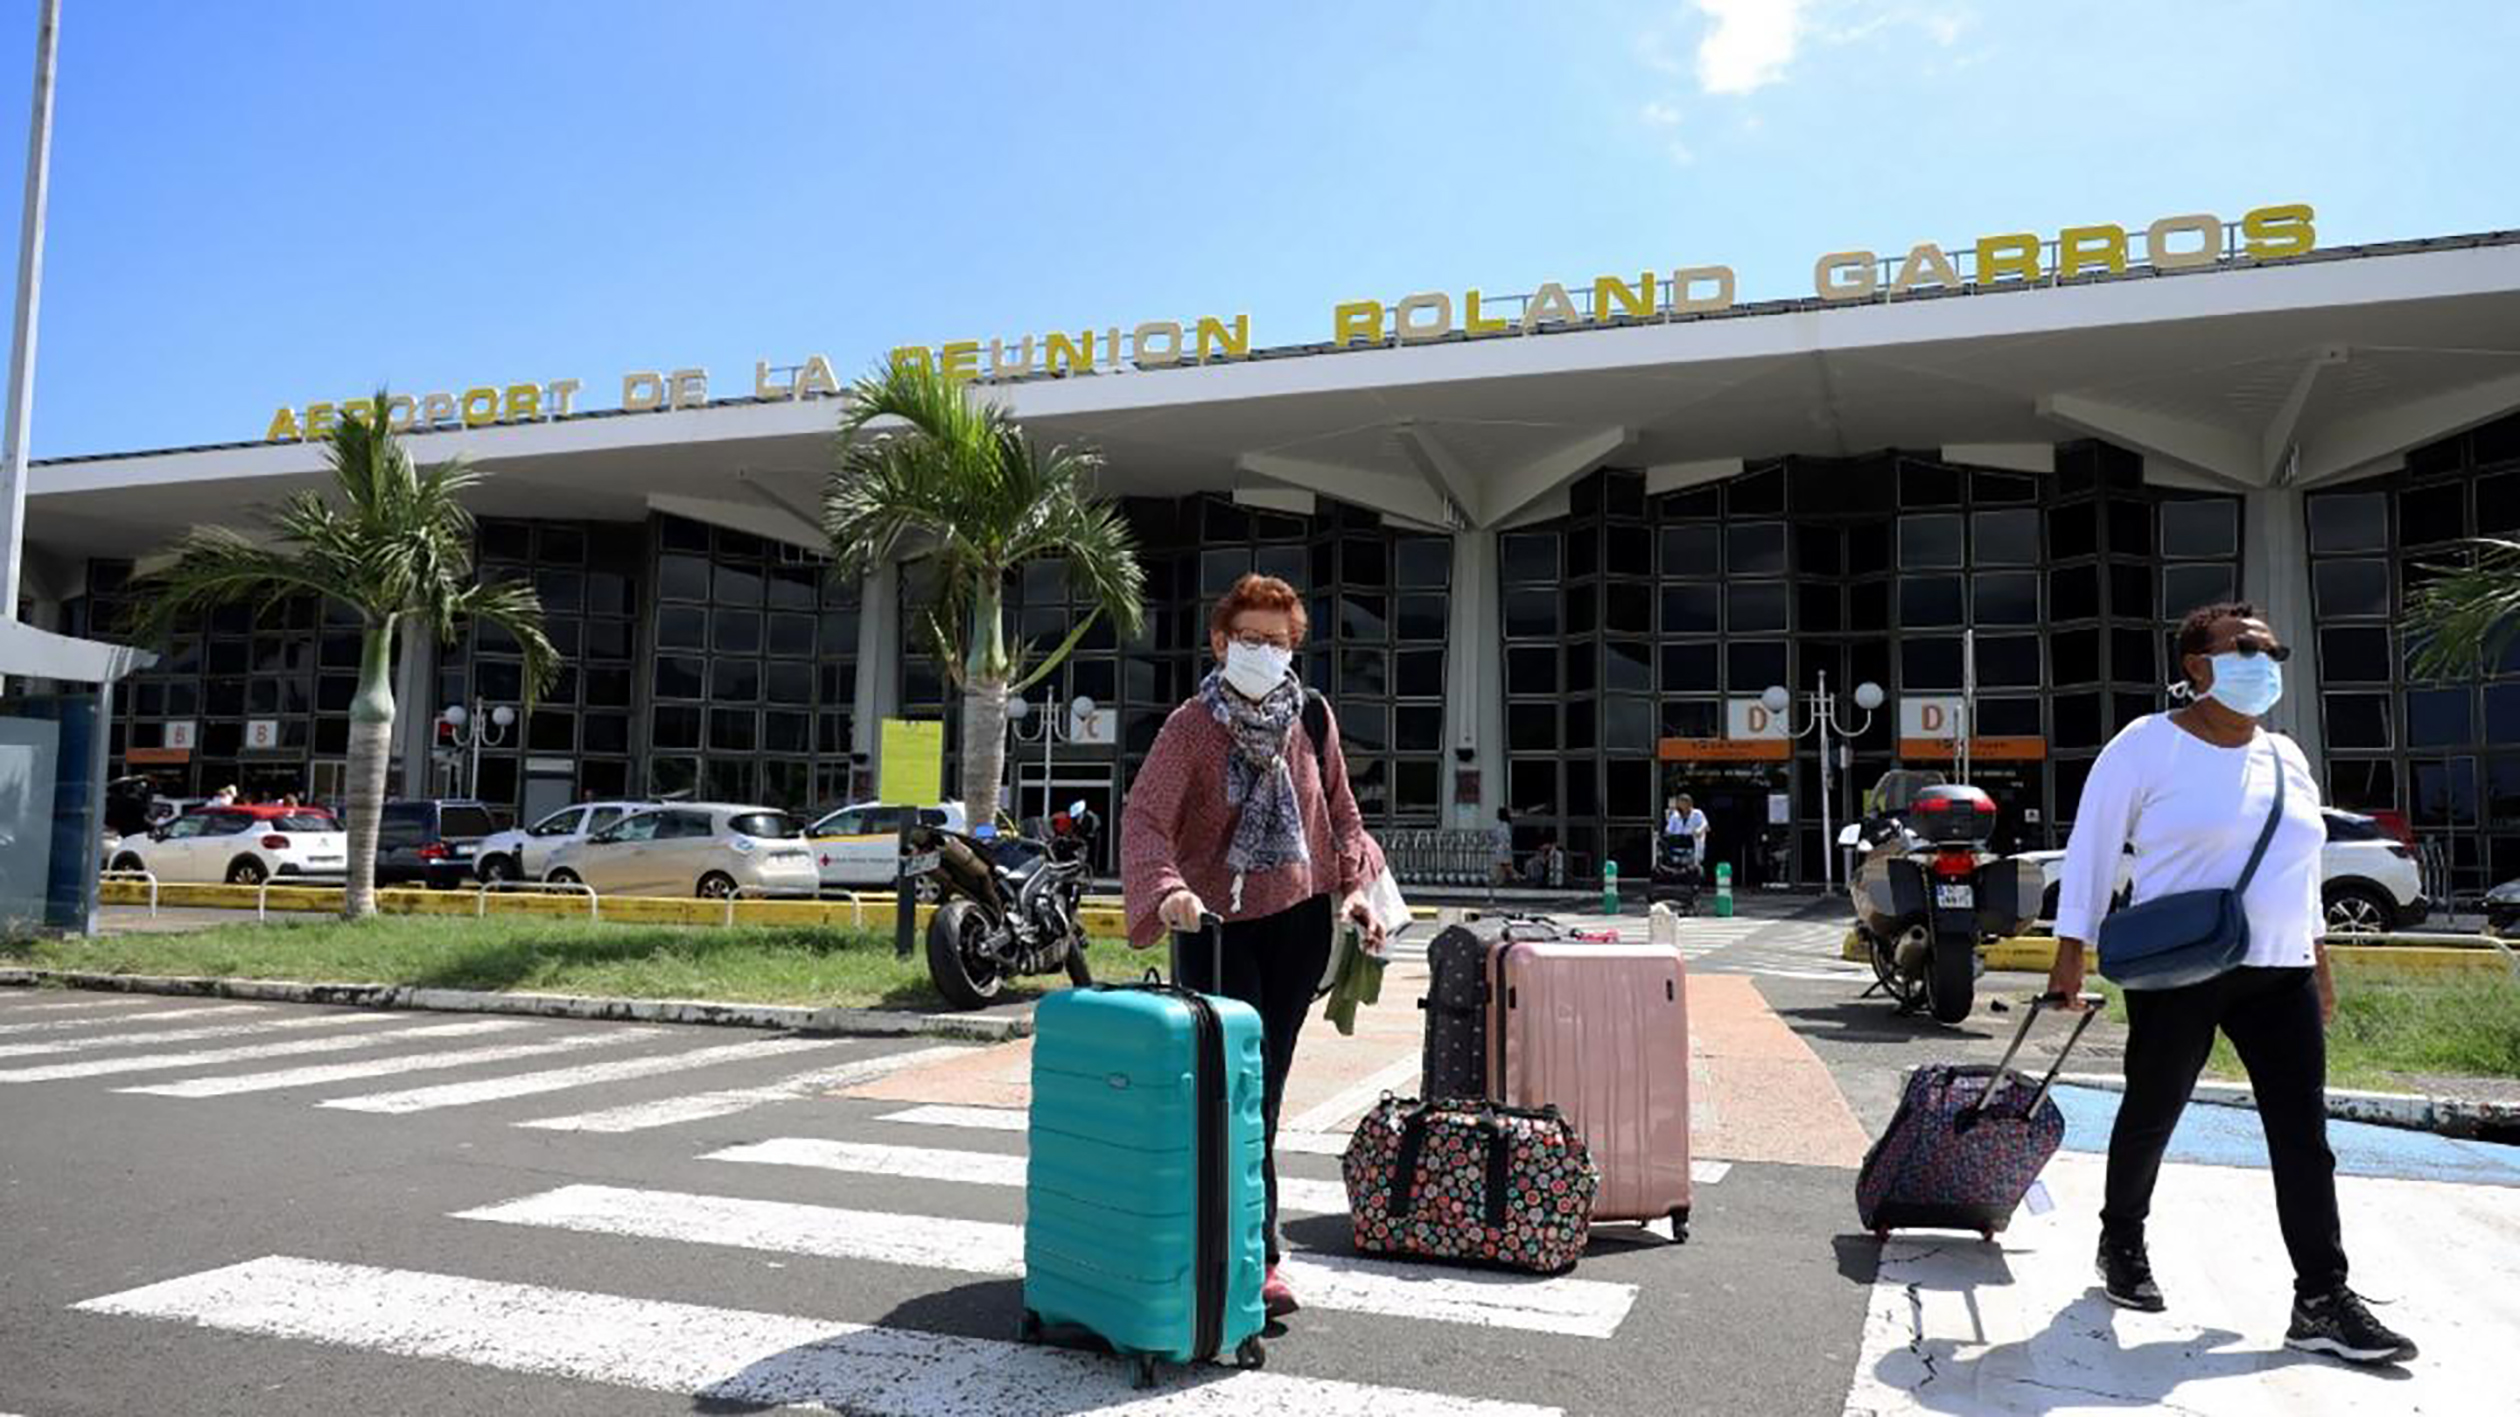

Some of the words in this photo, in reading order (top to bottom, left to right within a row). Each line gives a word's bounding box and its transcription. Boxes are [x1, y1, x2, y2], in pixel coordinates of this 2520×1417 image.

[624, 369, 707, 412] DE
[756, 353, 842, 399] LA
[1334, 264, 1736, 347] ROLAND
[1815, 203, 2316, 303] GARROS
[1087, 714, 1101, 738] C
[1748, 705, 1767, 733] D
[1922, 705, 1944, 731] D
